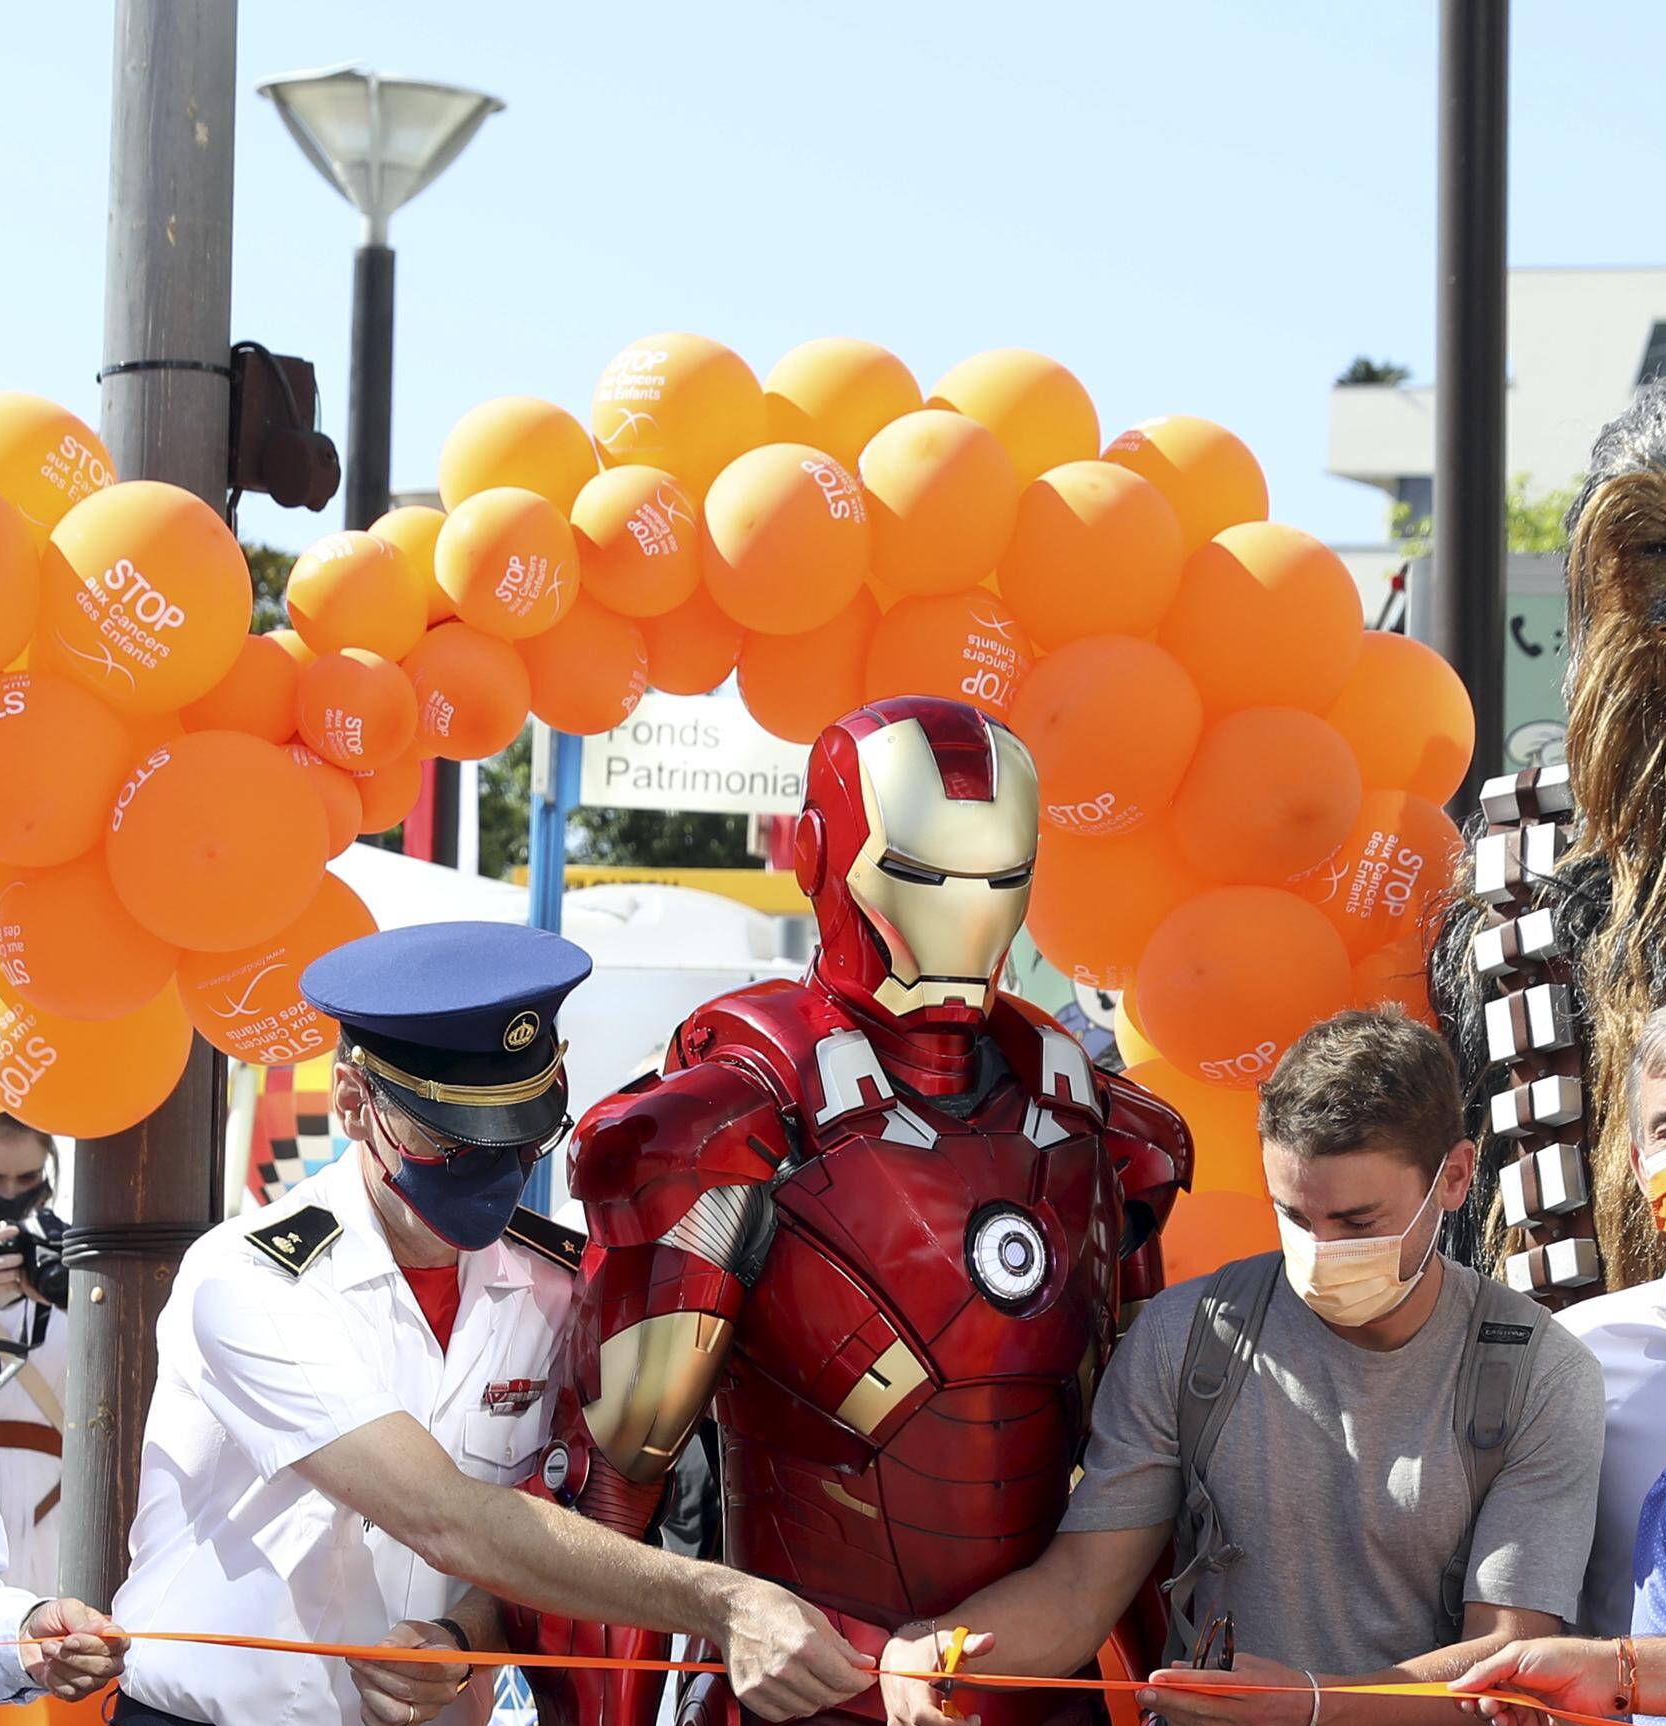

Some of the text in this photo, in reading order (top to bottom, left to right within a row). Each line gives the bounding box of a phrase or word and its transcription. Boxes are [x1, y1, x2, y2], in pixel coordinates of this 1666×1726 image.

[41, 464, 66, 489] des
[46, 450, 71, 475] aux
[800, 460, 850, 519] STOP
[627, 520, 659, 556] STOP
[104, 558, 185, 632] STOP
[495, 555, 526, 603] STOP
[76, 590, 158, 670] des Enfants
[84, 576, 172, 659] aux Cancers
[962, 648, 1014, 678] Cancers
[967, 634, 1016, 664] Enfants
[961, 669, 1012, 708] TOP
[345, 716, 364, 756] STOP
[436, 702, 454, 737] STOP
[112, 753, 171, 832] STOP
[606, 755, 800, 797] Patrimonia
[1047, 792, 1116, 825] STOP
[1346, 831, 1384, 914] des Enfants
[1361, 834, 1399, 918] aux Cancers
[1381, 848, 1424, 917] STOP
[10, 1014, 37, 1043] aux
[226, 1000, 309, 1040] des Enfants
[235, 1011, 318, 1050] aux Cancers
[259, 1028, 324, 1063] STOP
[1199, 1041, 1277, 1080] STOP
